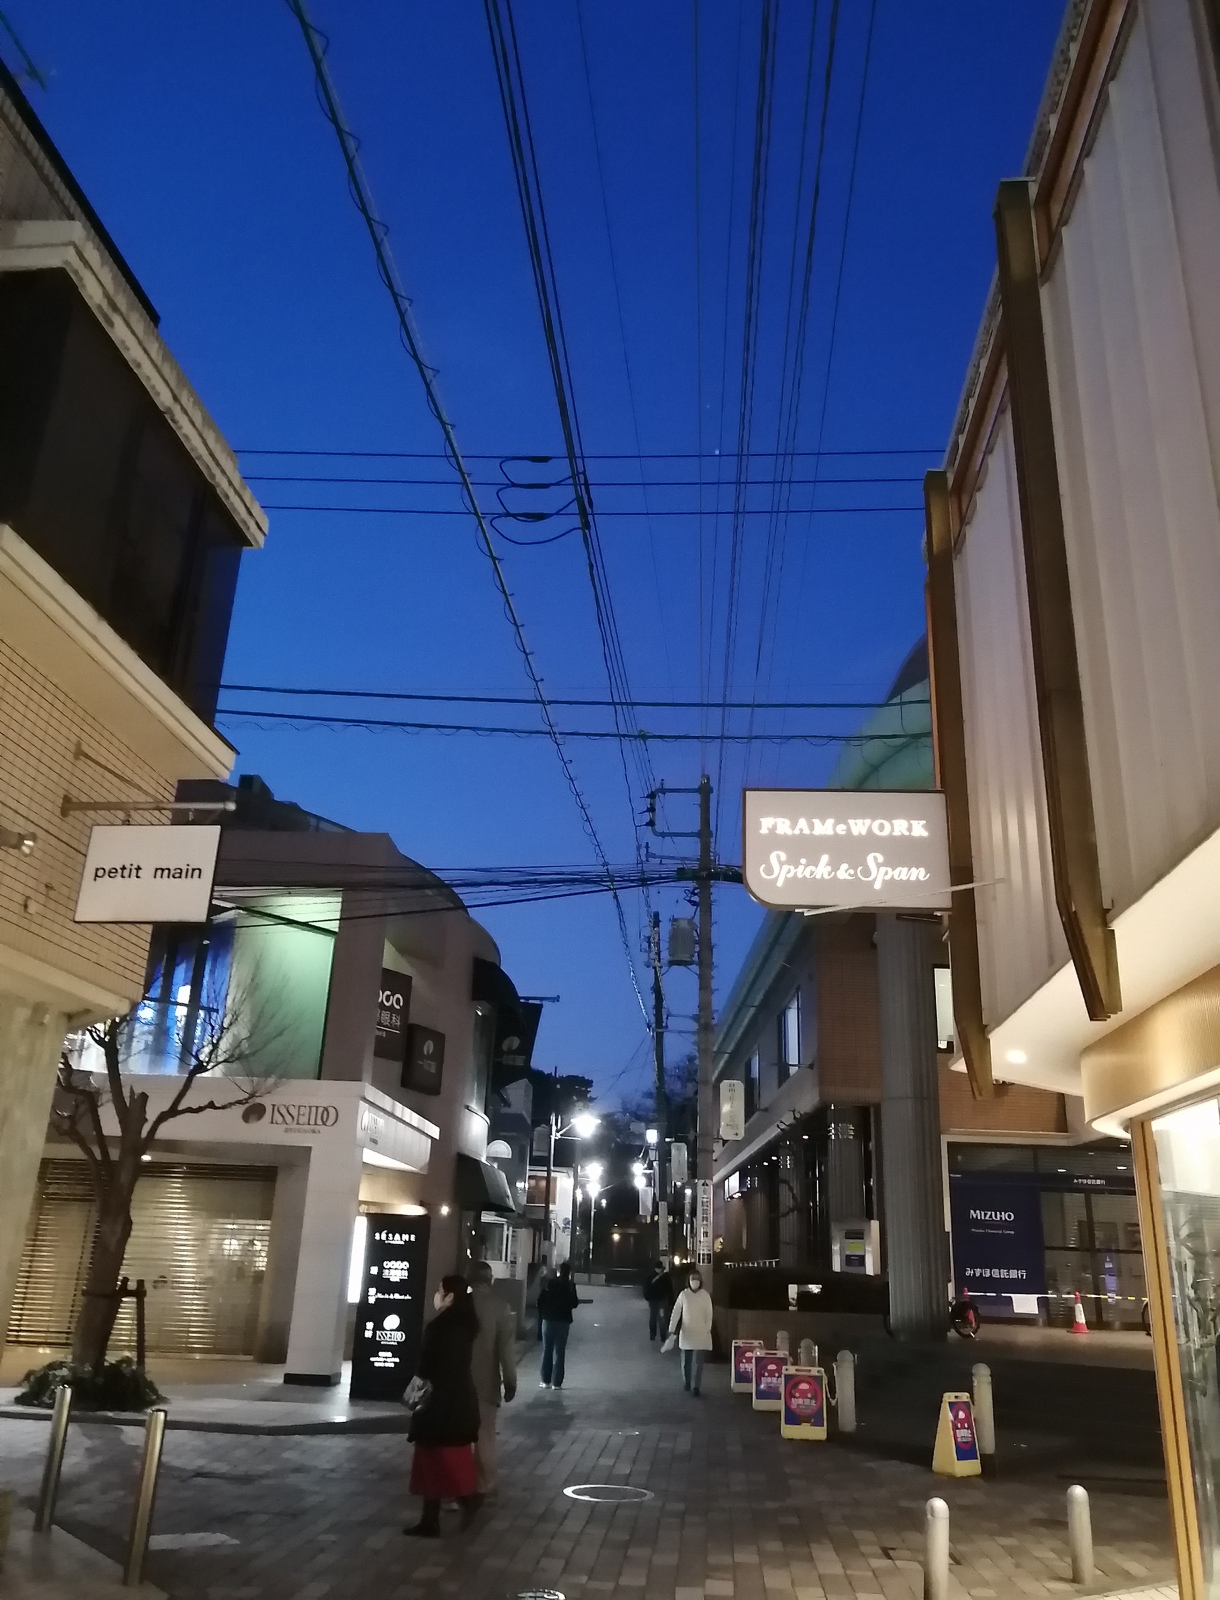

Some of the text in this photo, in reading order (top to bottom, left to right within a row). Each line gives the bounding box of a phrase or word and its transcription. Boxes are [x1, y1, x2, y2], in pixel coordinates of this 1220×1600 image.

[93, 863, 202, 882] petit main
[759, 850, 930, 890] Spick & Span
[969, 1209, 1015, 1222] MIZUHO
[965, 1267, 1028, 1280] みずほ信託銀行
